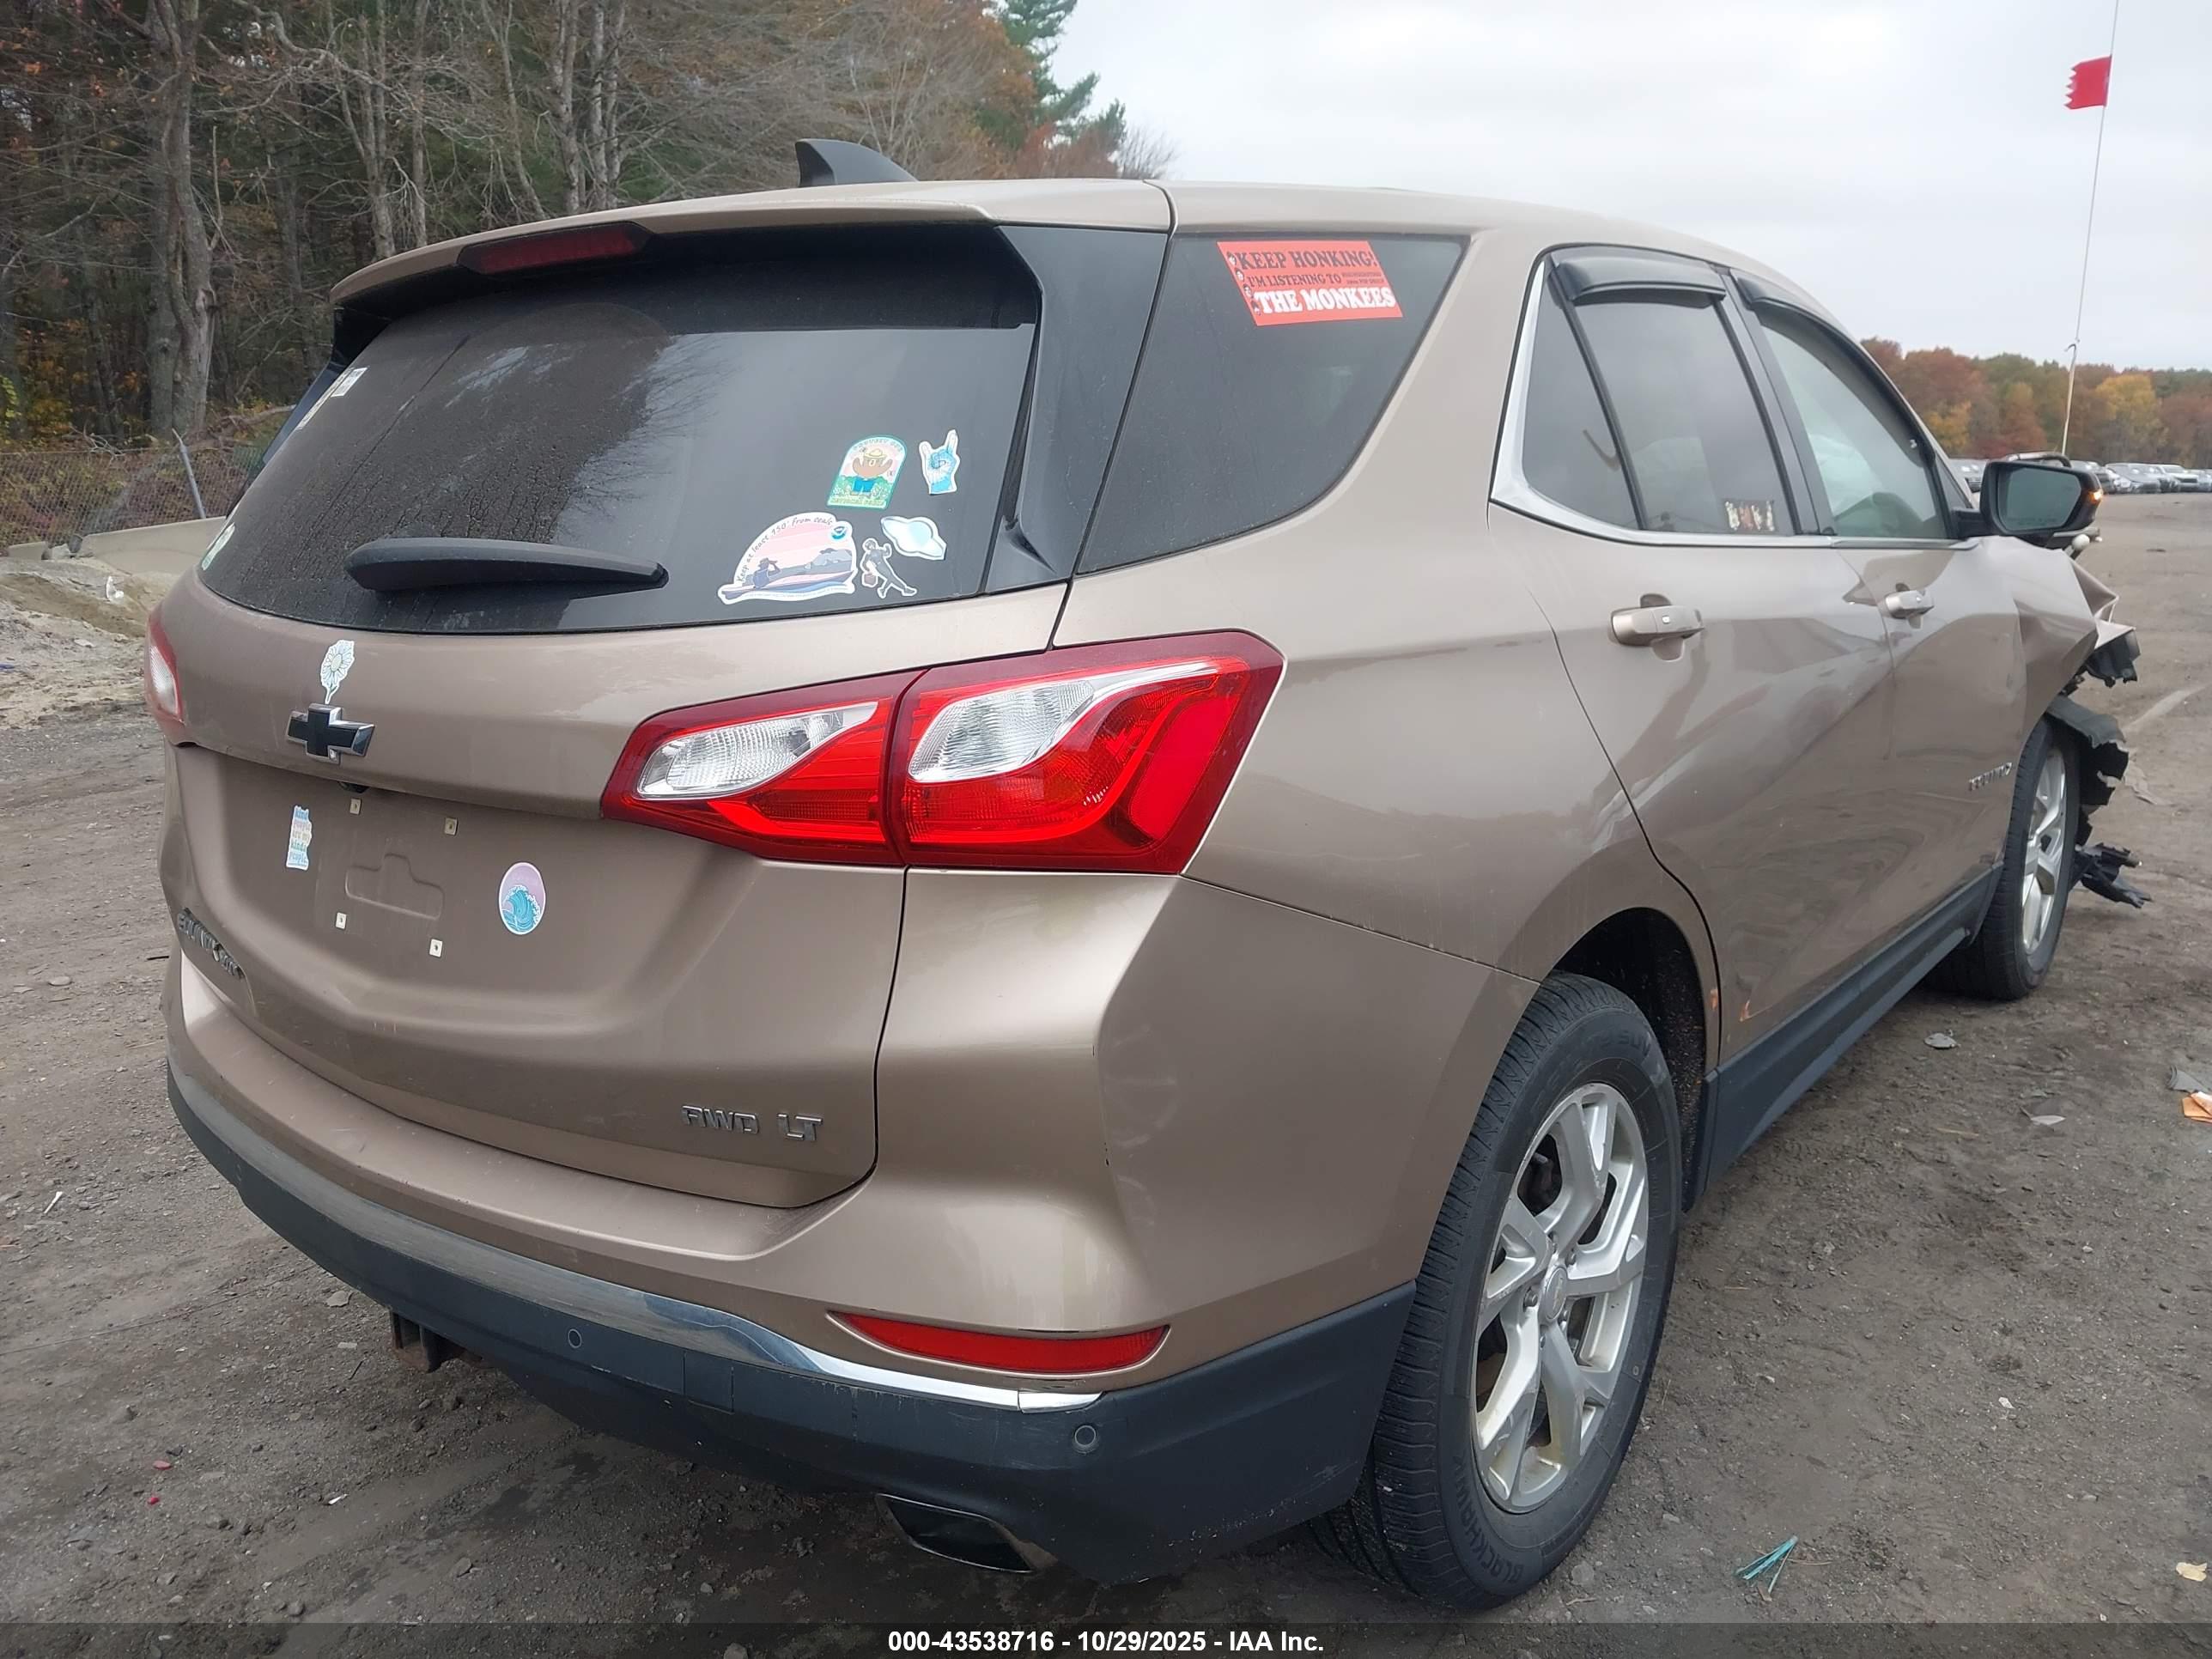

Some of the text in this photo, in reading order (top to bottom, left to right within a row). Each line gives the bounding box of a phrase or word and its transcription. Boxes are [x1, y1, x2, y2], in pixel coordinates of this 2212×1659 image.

[1234, 250, 1381, 270] KEEP HONKING!
[1247, 275, 1267, 288] I'M
[1267, 274, 1326, 287] LISTENING
[1326, 273, 1342, 284] TO
[1255, 287, 1397, 314] THE MONKEES
[736, 566, 750, 583] Keep
[751, 534, 769, 552] least
[792, 517, 811, 527] from
[682, 1105, 823, 1141] AWD LT
